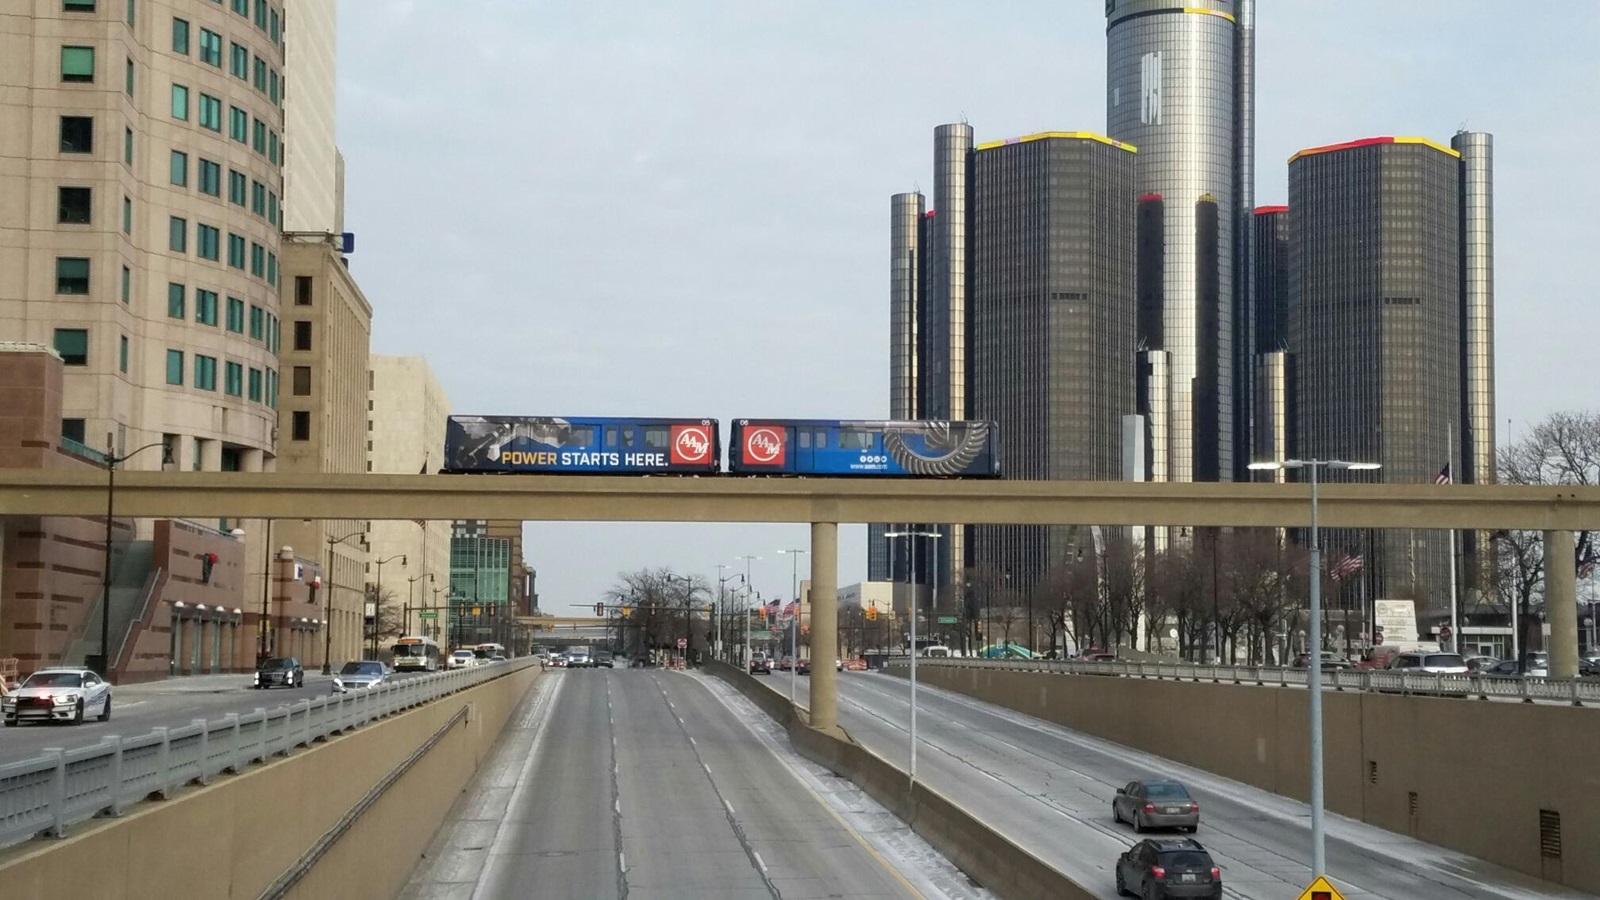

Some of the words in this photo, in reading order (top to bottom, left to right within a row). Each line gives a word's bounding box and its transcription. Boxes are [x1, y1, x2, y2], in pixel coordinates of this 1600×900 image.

[680, 433, 709, 454] AAM
[752, 433, 781, 455] AAM
[502, 451, 557, 465] POWER
[562, 452, 619, 466] STARTS
[625, 453, 668, 467] HERE.
